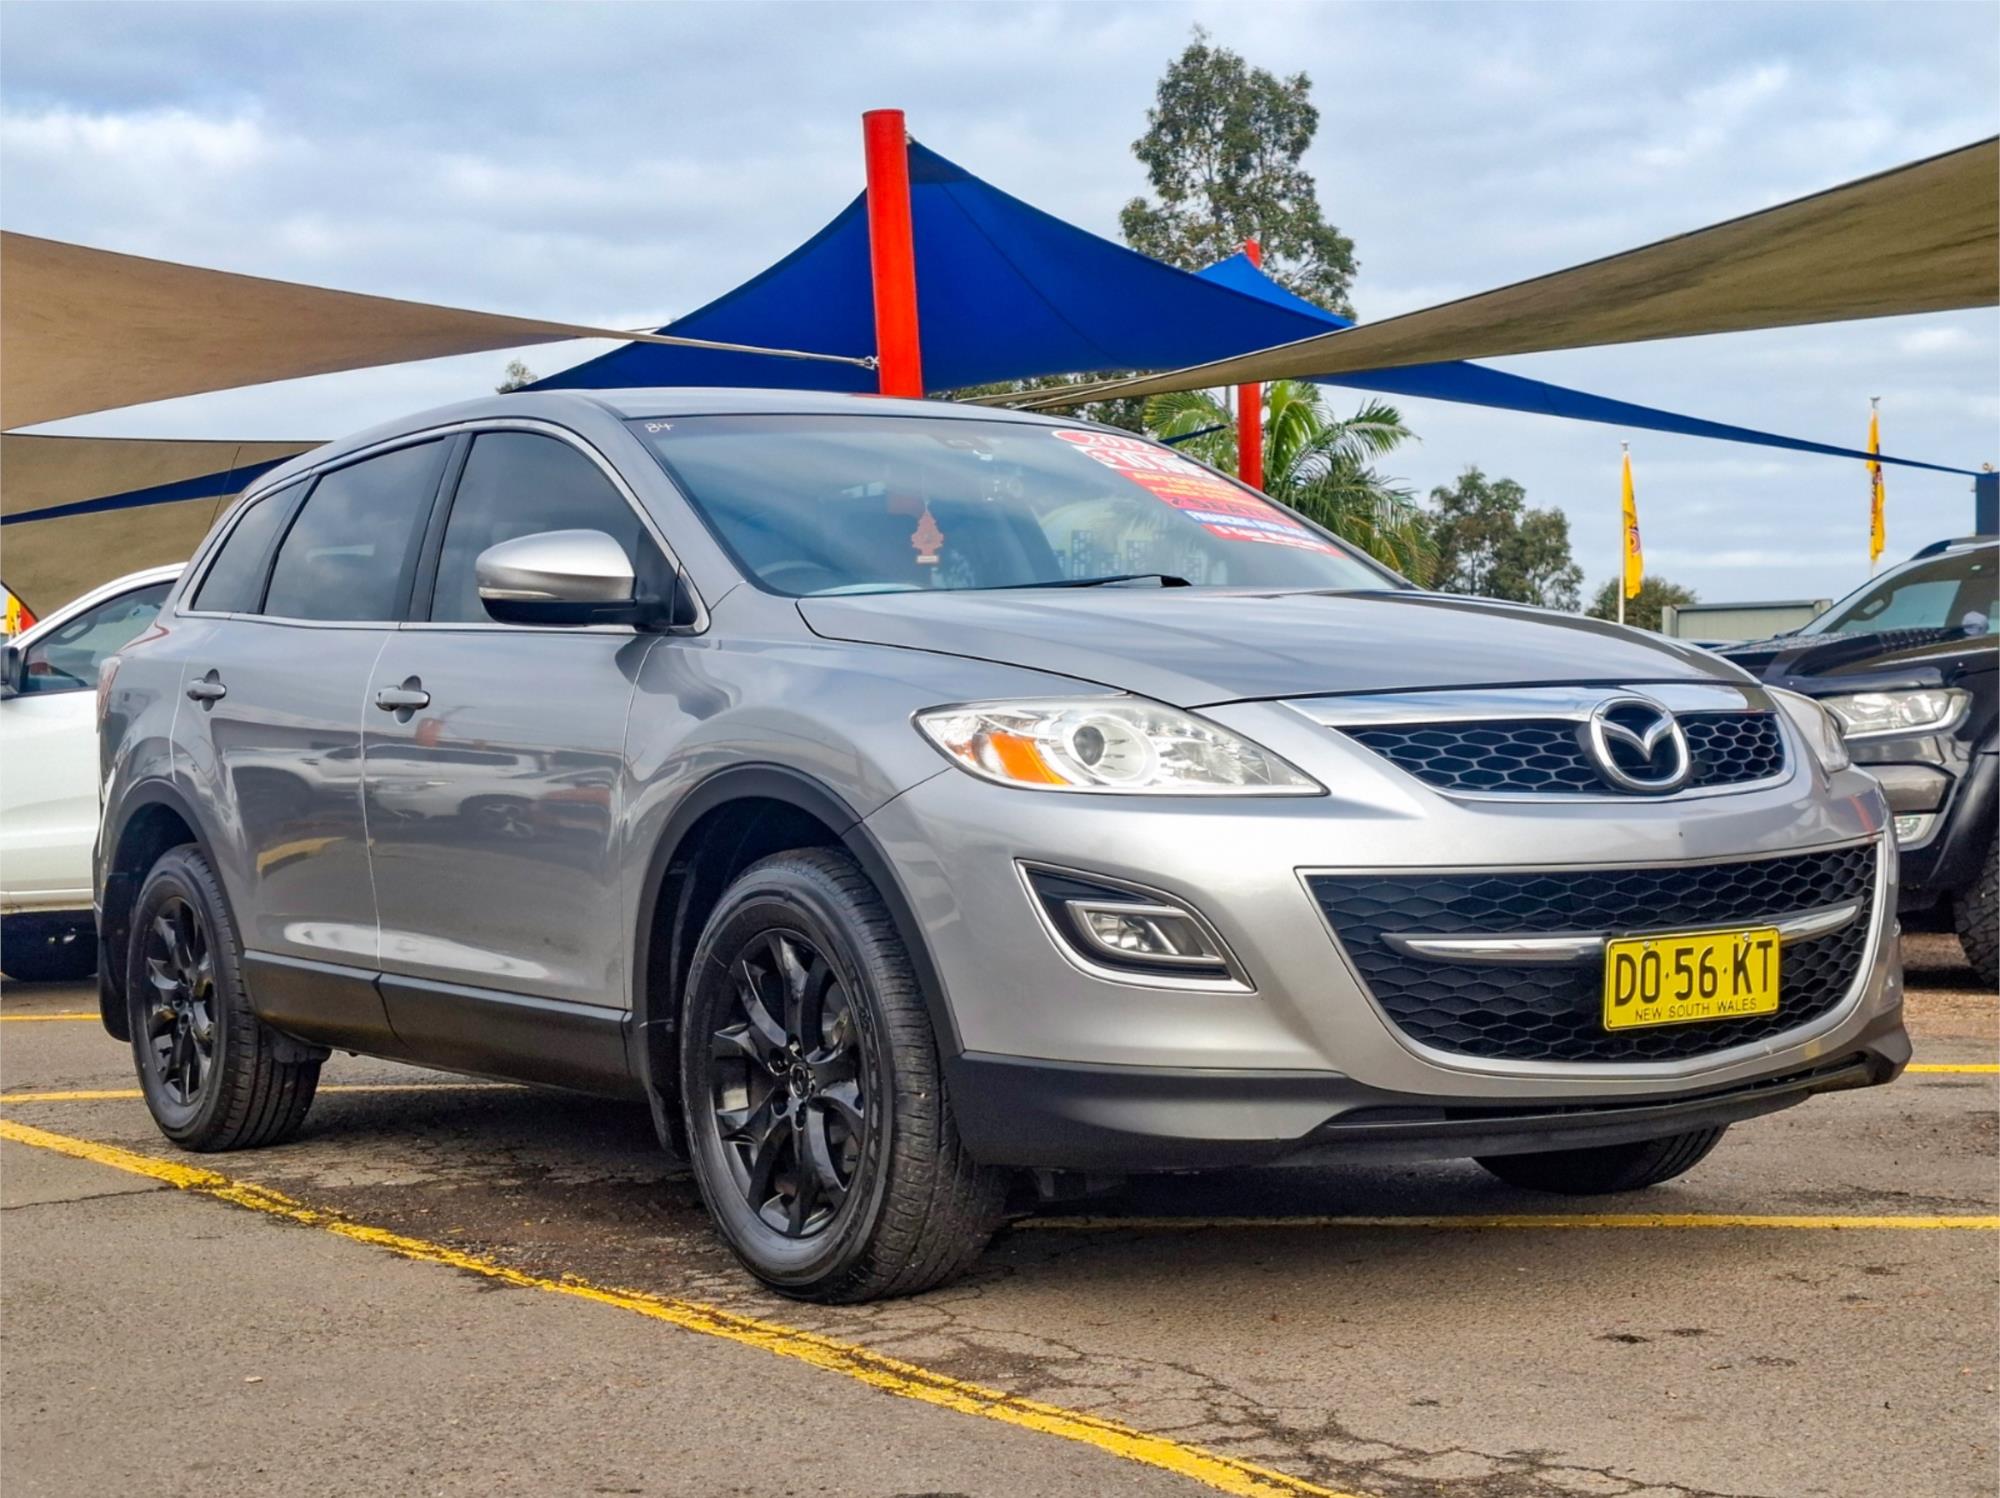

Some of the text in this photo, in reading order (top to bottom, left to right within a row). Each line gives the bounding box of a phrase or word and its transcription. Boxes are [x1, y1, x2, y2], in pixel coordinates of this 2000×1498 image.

[1635, 998, 1757, 1022] NEW SOUTH WALES
